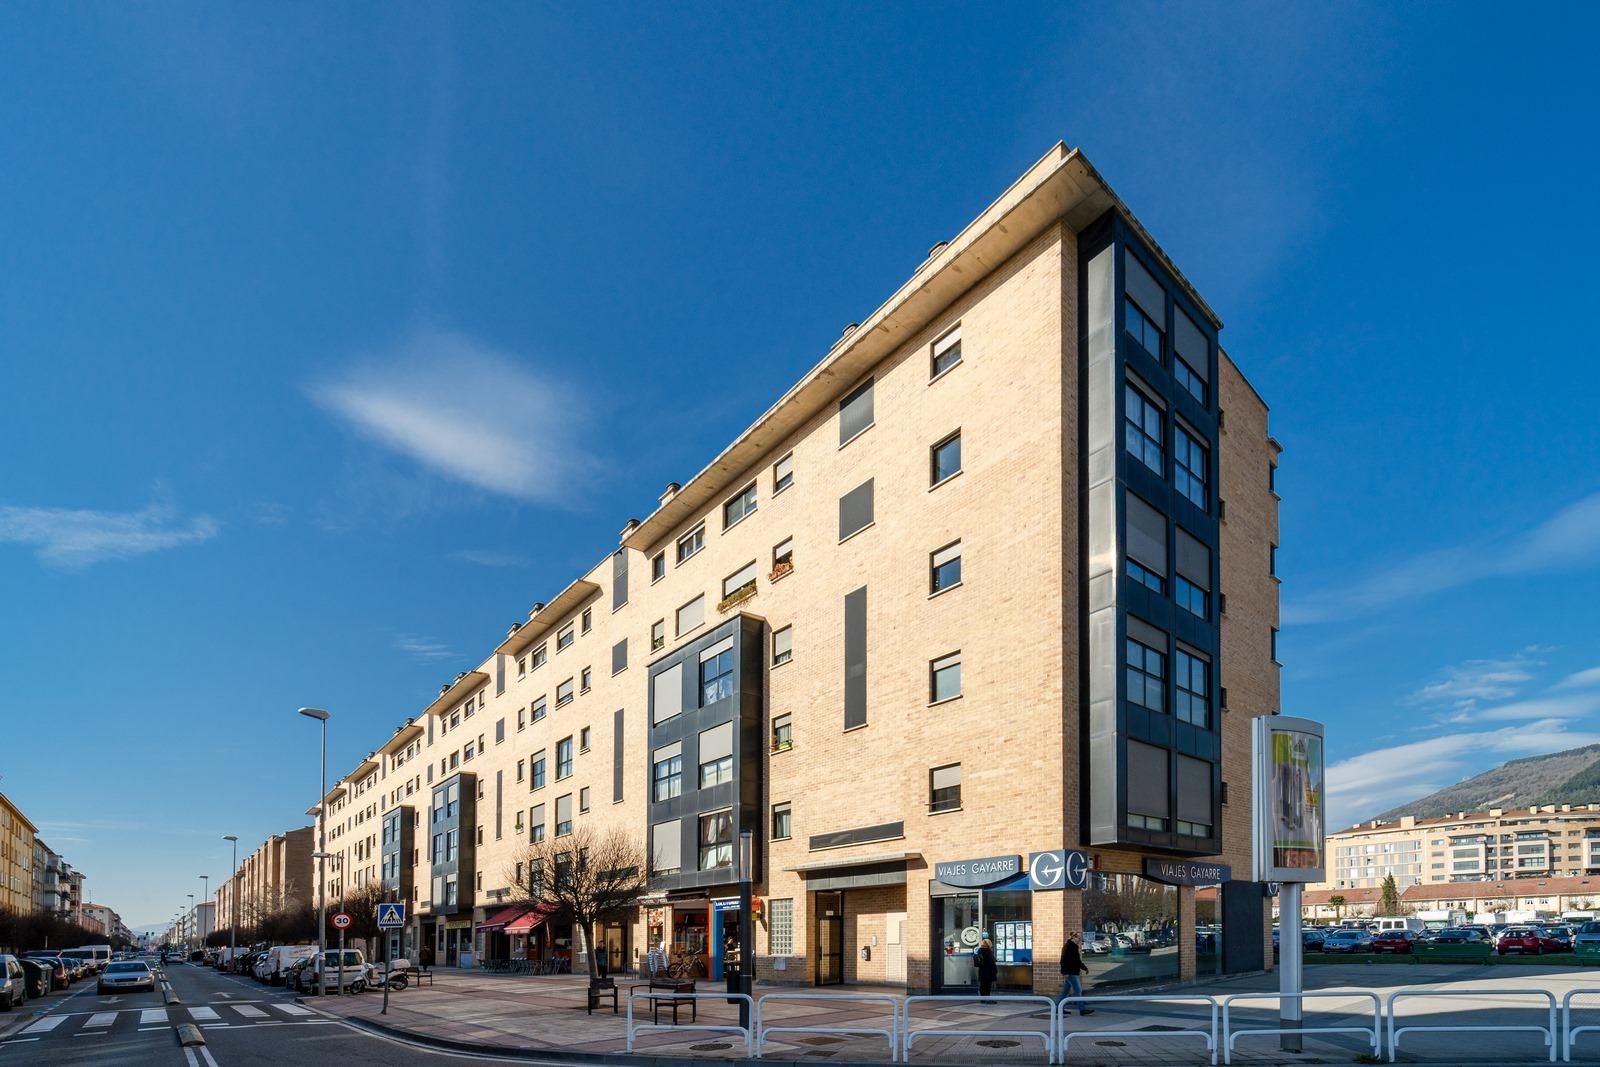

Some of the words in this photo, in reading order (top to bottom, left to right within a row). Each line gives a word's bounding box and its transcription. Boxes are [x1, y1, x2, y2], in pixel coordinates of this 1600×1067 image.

[938, 864, 966, 876] VIAJES
[971, 859, 1014, 874] GAYARRE
[1031, 852, 1064, 886] G
[1161, 864, 1185, 877] VIAJES
[1190, 866, 1220, 879] GAYARRE
